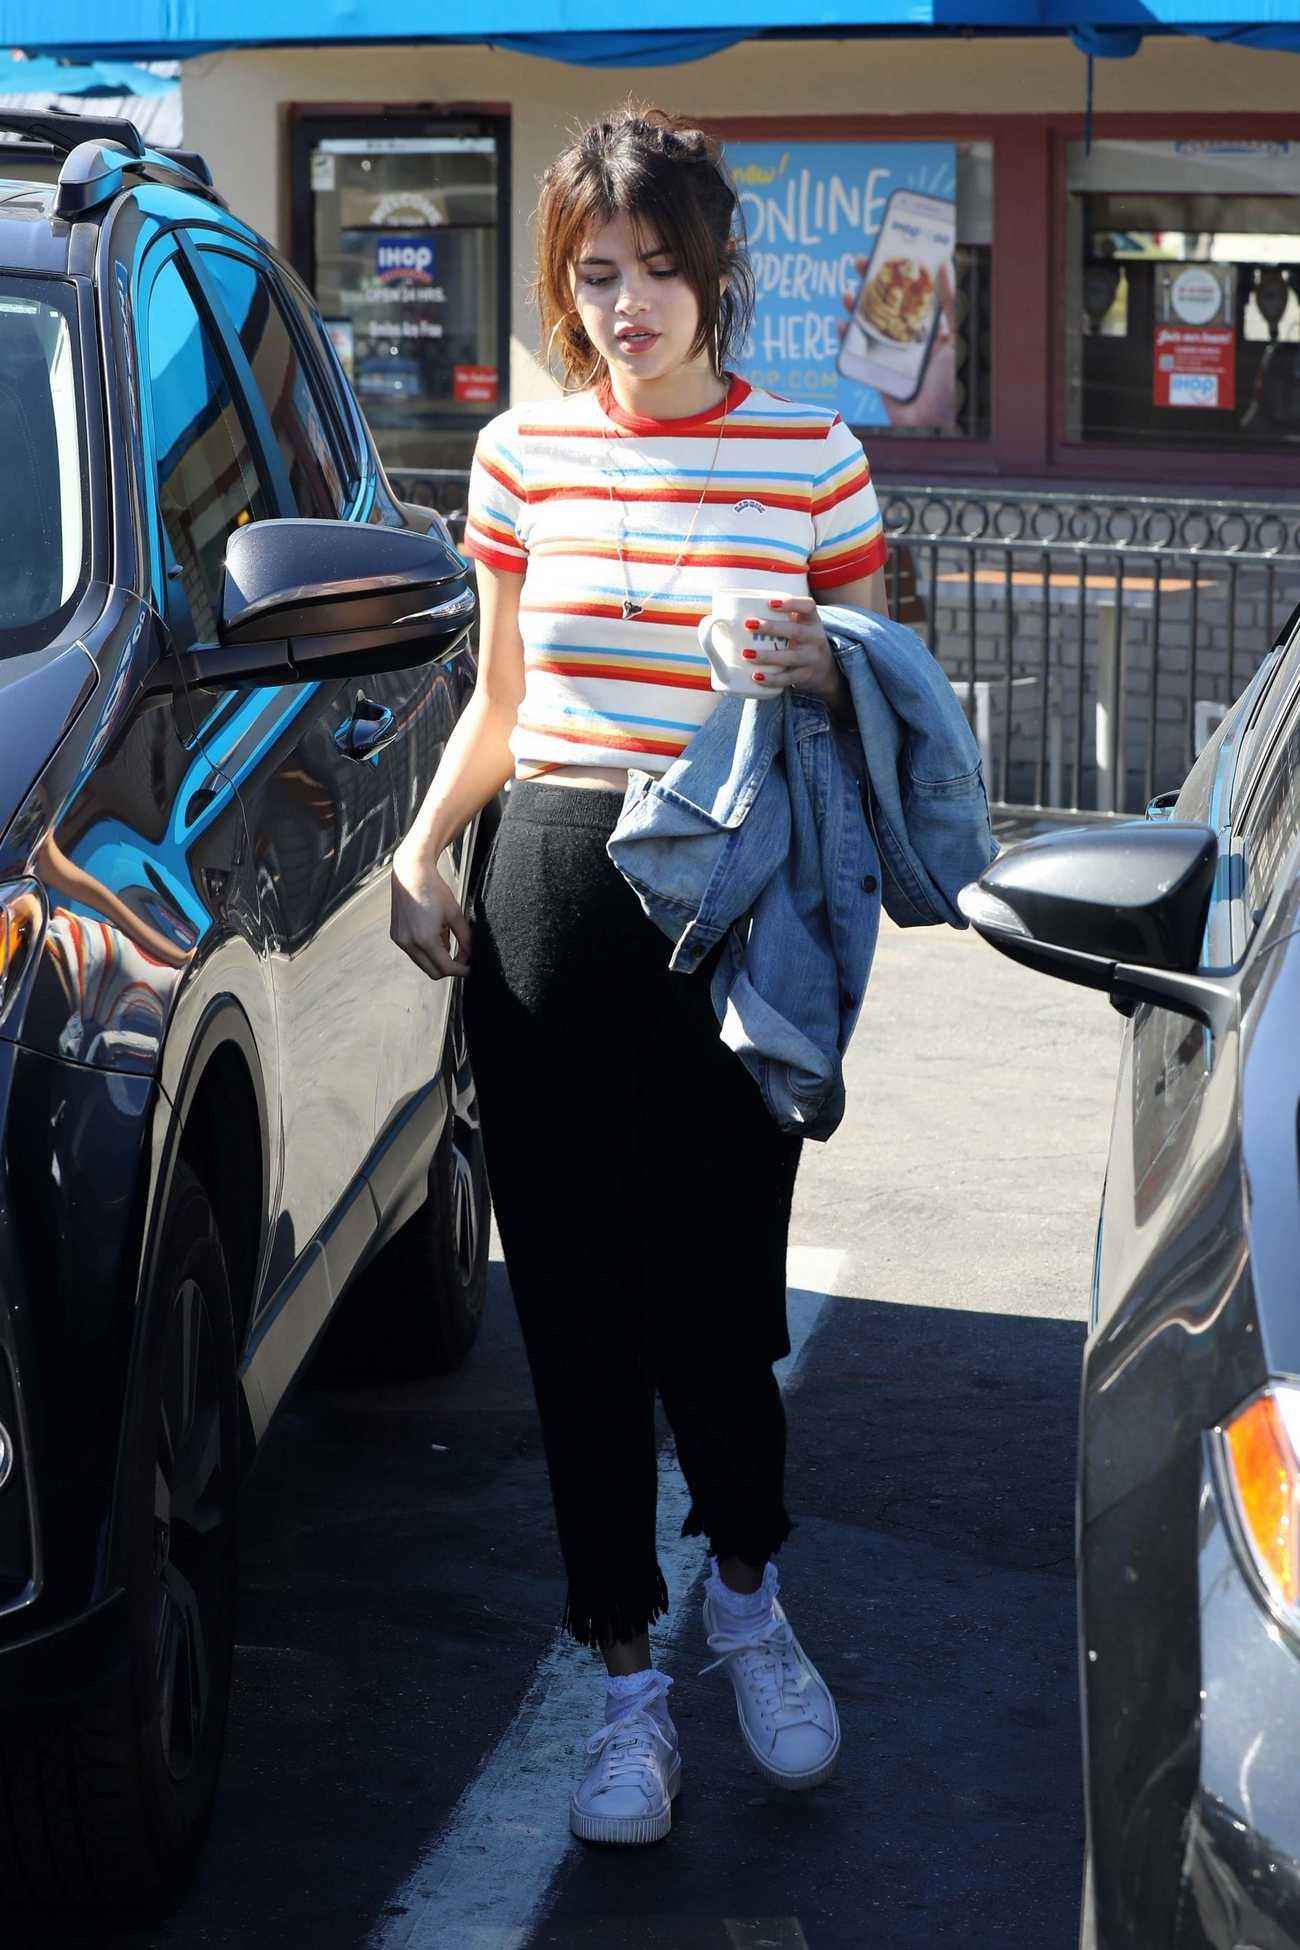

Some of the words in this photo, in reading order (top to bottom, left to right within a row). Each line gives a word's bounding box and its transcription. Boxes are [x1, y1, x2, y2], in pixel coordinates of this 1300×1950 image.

[736, 168, 891, 247] ONLINE
[378, 245, 433, 272] IHOP
[750, 252, 860, 303] RDERING
[762, 311, 838, 362] HERE
[750, 368, 838, 389] OP.COM
